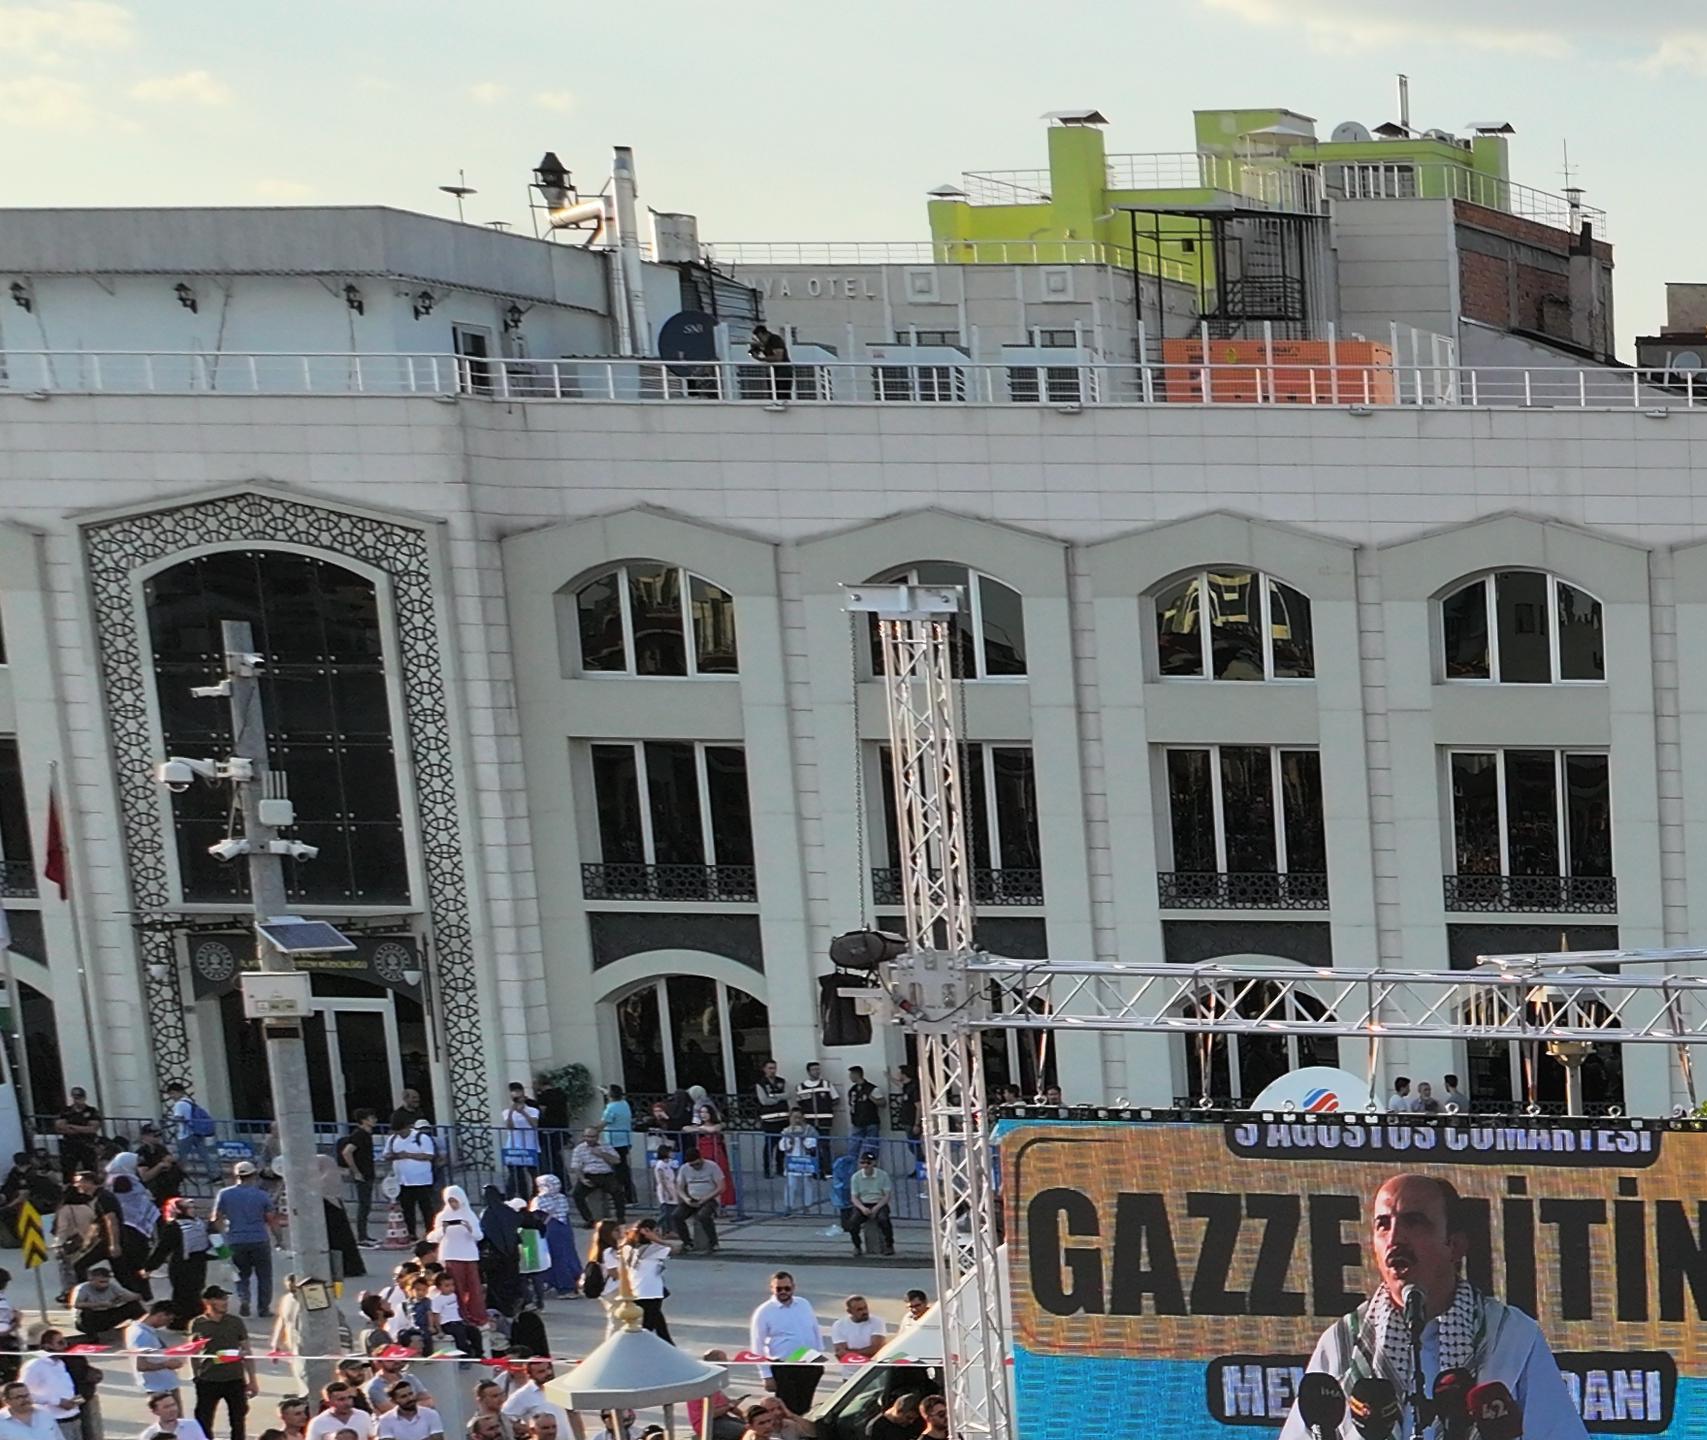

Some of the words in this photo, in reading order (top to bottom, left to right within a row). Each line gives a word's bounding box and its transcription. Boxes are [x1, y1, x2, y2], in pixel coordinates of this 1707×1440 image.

[807, 277, 876, 298] OTEL
[1027, 1187, 1361, 1317] GAZZE
[1482, 1400, 1508, 1420] 42
